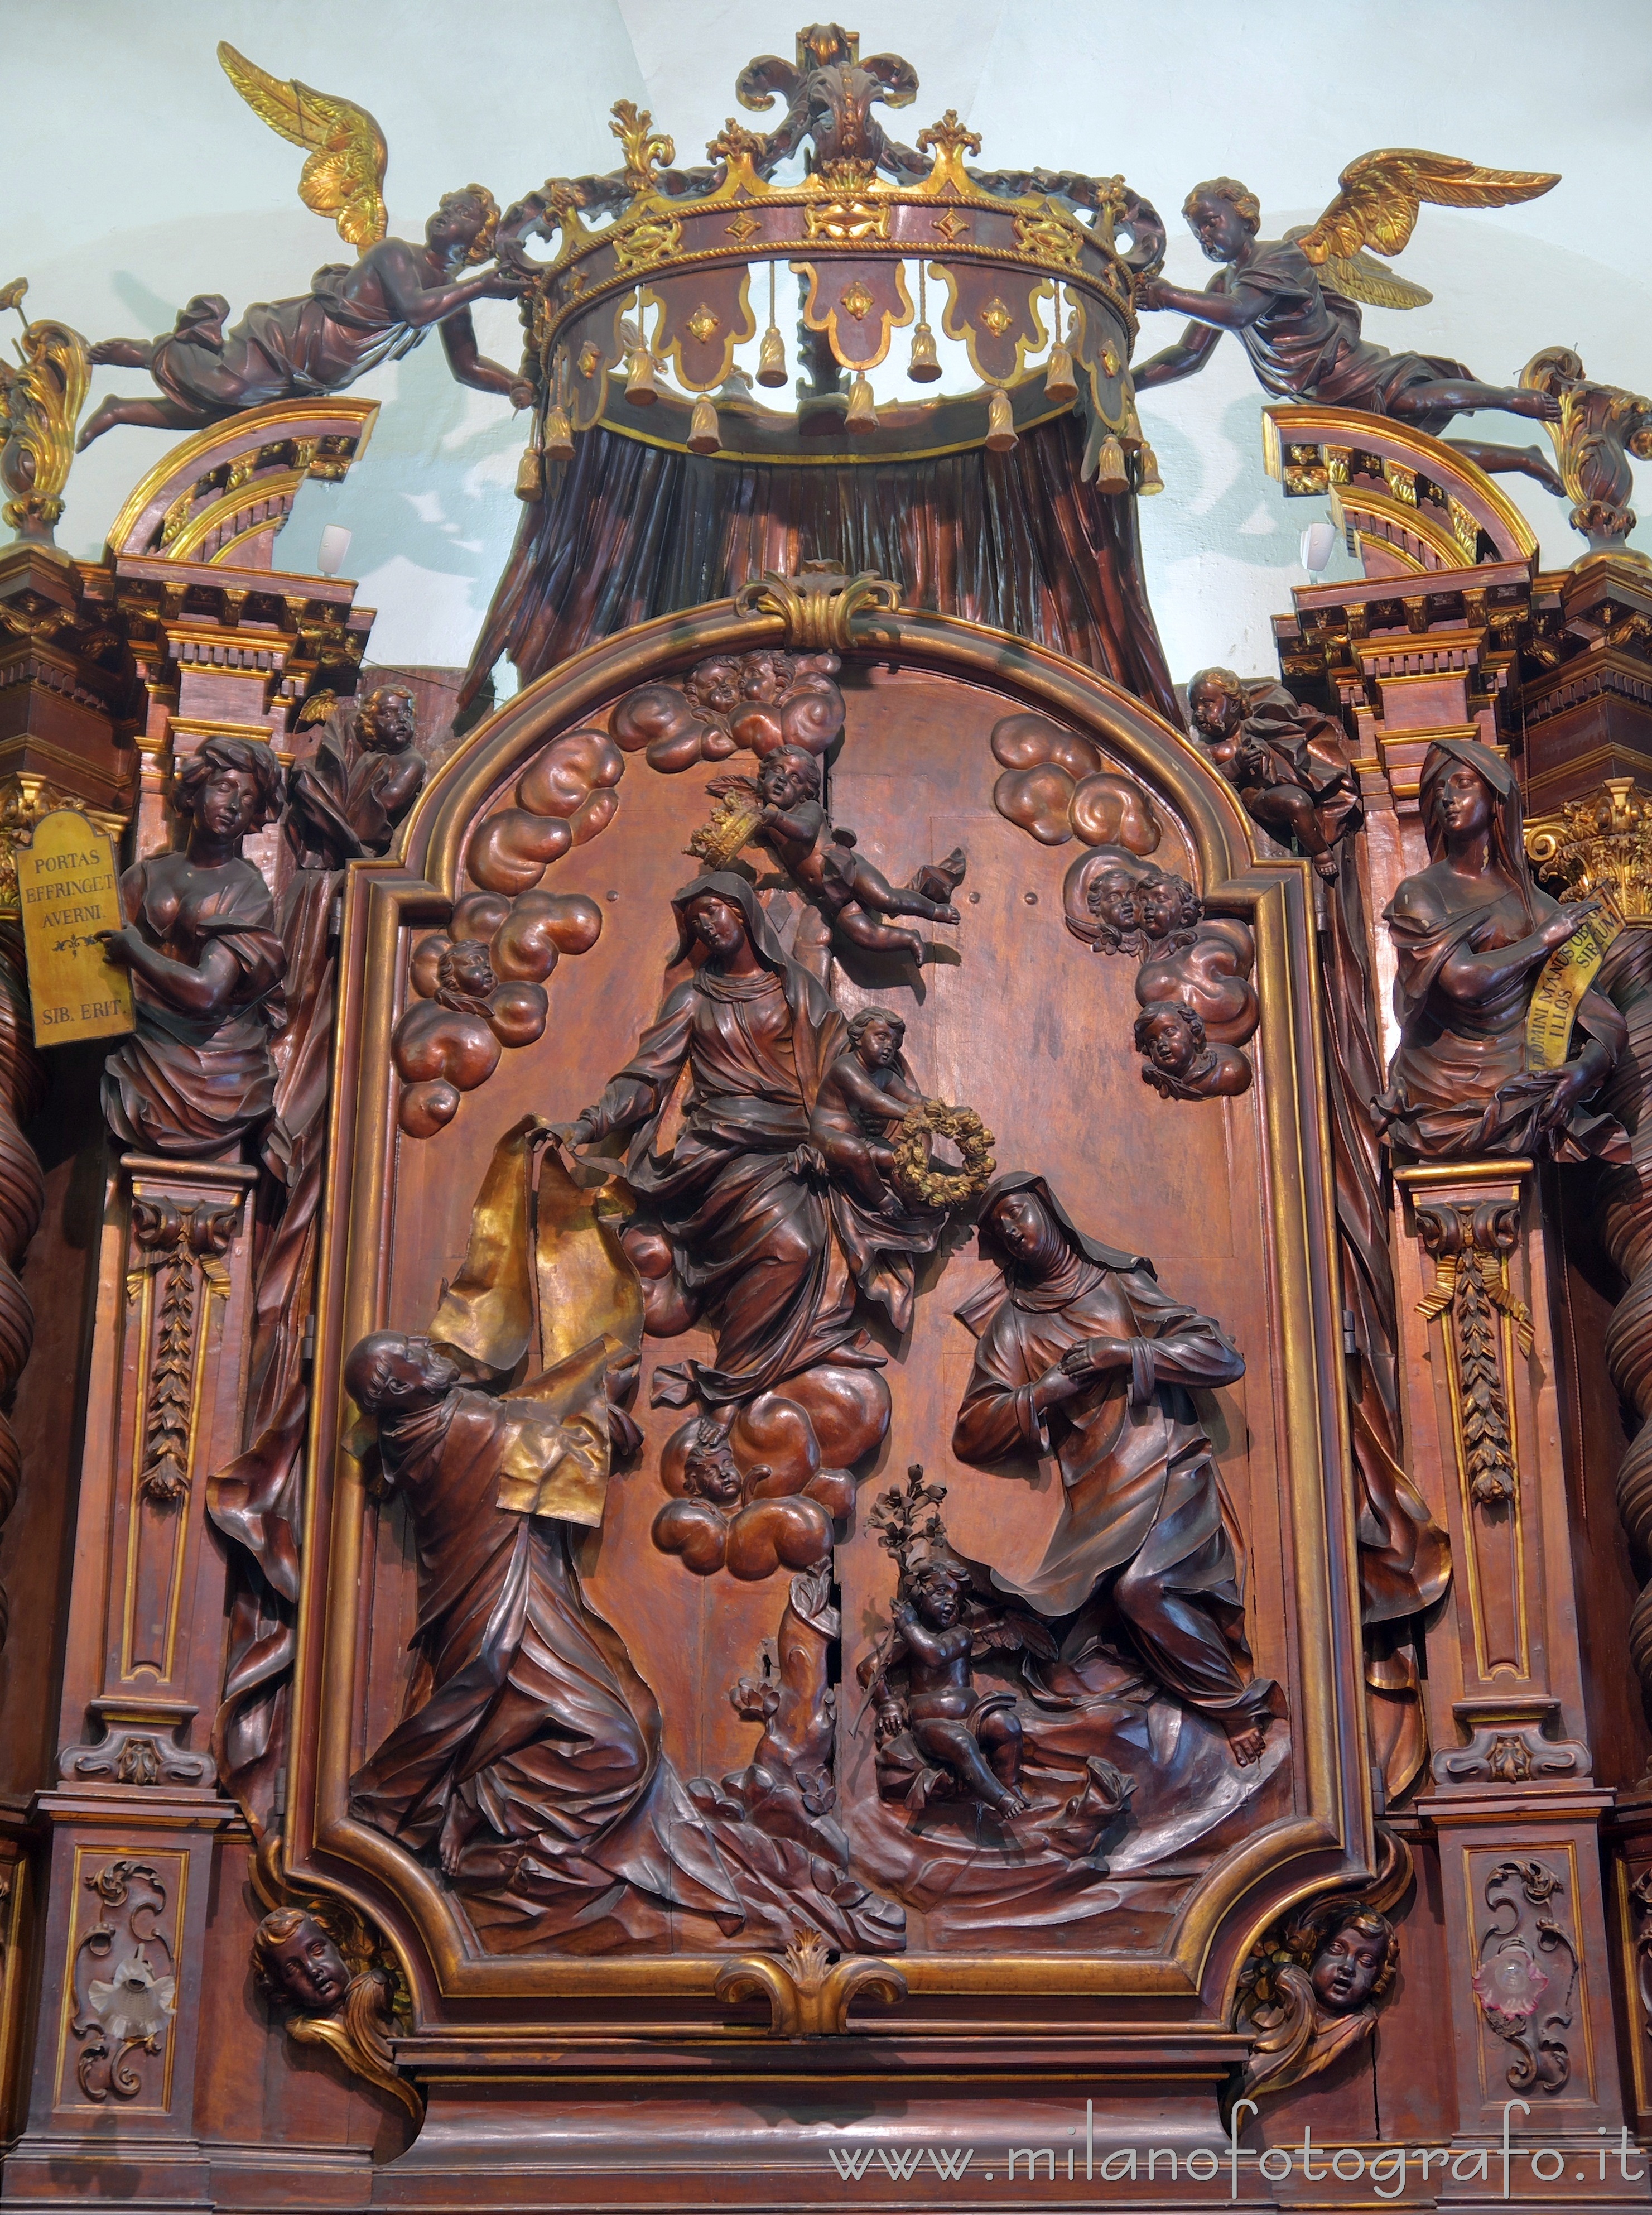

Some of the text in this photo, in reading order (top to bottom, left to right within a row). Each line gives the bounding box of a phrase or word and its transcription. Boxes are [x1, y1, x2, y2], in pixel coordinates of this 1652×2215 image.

[35, 849, 100, 874] PORTAS
[25, 873, 113, 904] EFFRINGET
[41, 904, 106, 929] AVERNI.
[1593, 911, 1620, 945] CUM
[1538, 945, 1574, 1003] MANUS
[42, 1007, 75, 1025] SIB.
[1531, 1008, 1549, 1067] DOMINI
